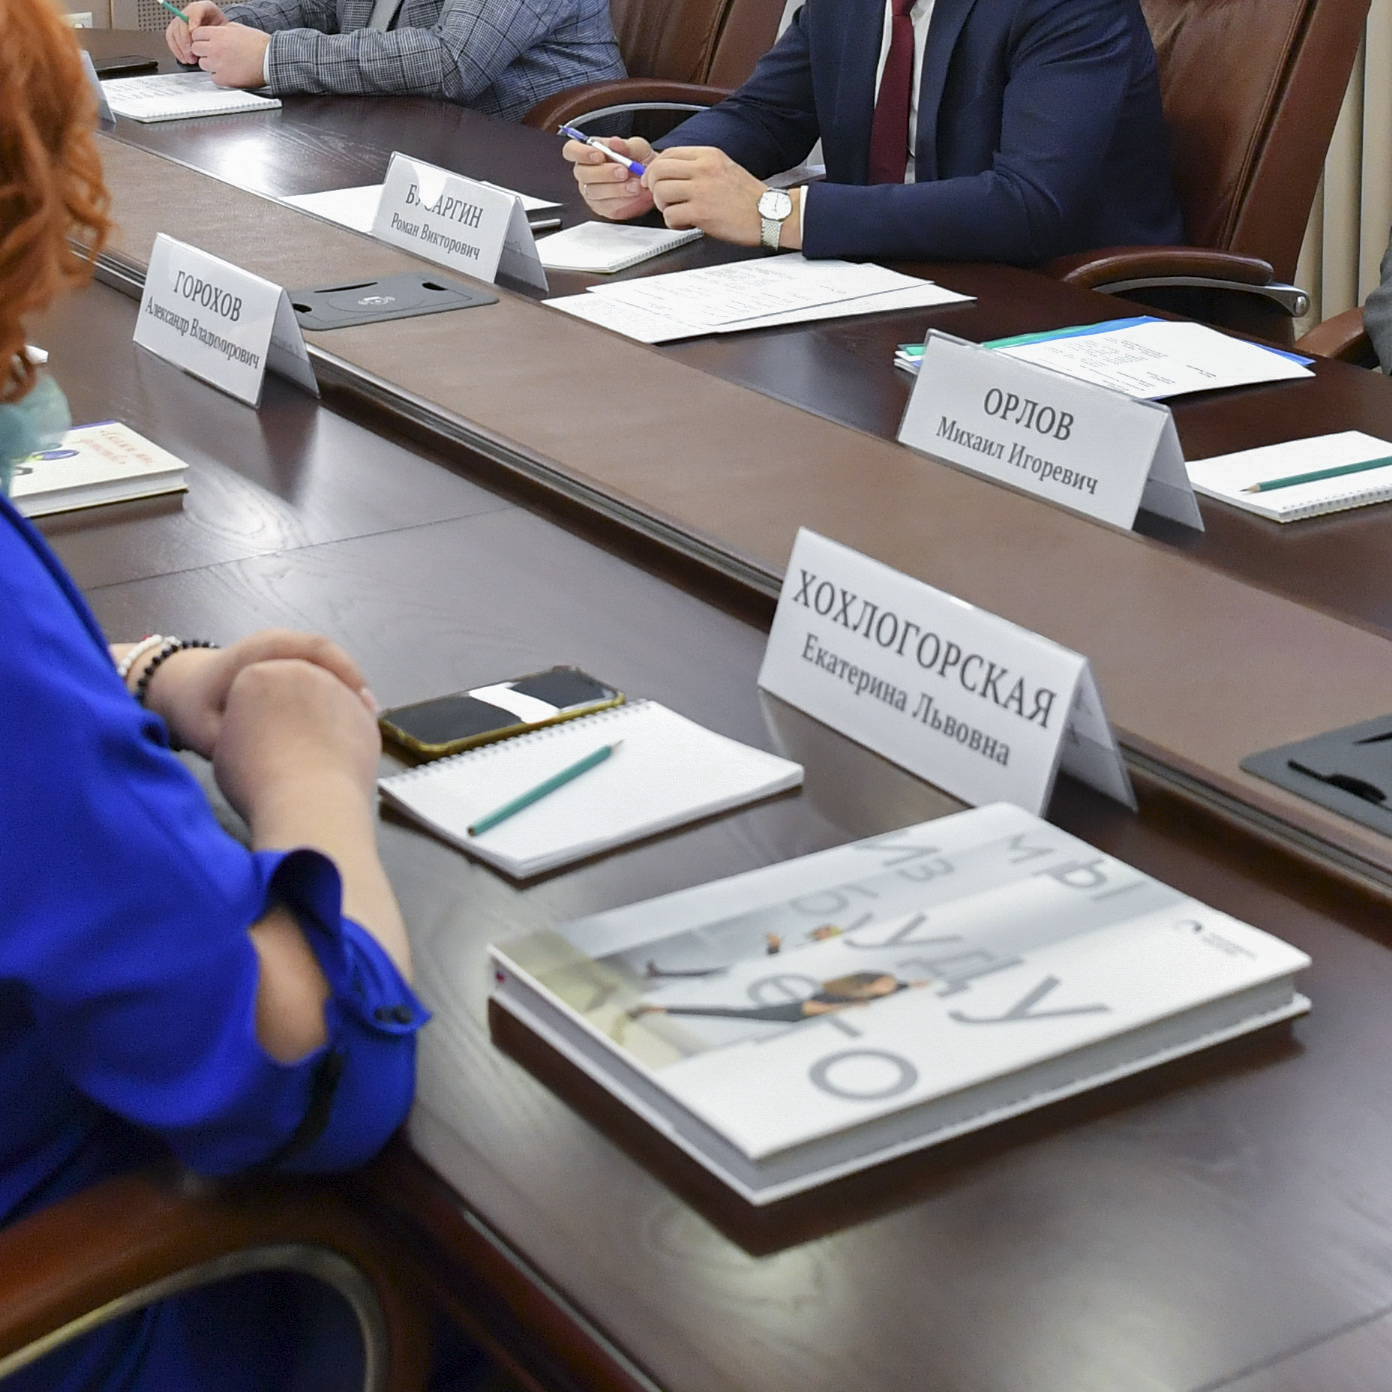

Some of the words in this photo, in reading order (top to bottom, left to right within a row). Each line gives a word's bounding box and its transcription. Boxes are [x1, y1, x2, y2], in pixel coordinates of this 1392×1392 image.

[390, 212, 420, 237] Роман
[420, 224, 481, 260] Викторович
[405, 184, 484, 228] БАРГИН
[173, 270, 243, 322] ГОРОХОВ
[145, 296, 190, 336] Александр
[190, 318, 260, 369] Владимирович
[983, 387, 1075, 441] ОРЛОВ
[935, 416, 1006, 460] Михаил
[1007, 442, 1099, 495] Игоревич
[792, 569, 1057, 729] ХОХЛОГОРСКАЯ
[801, 633, 908, 711] Екатерина
[911, 693, 1012, 767] Львовна
